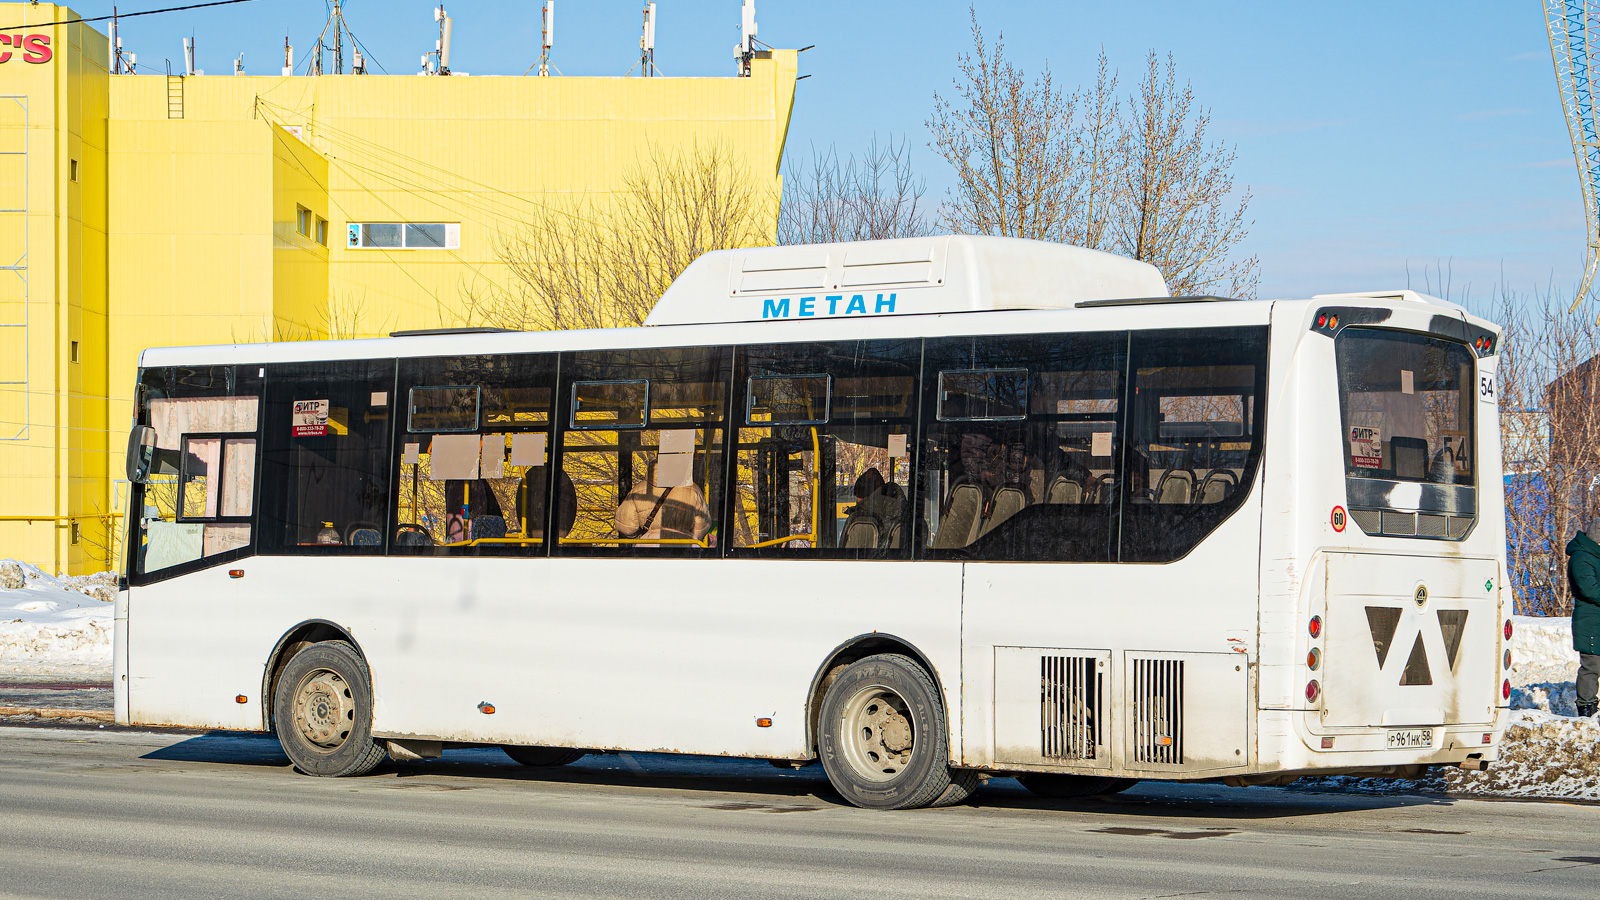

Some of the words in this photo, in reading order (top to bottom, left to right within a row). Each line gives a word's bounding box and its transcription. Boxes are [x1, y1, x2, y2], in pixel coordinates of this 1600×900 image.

[762, 293, 897, 319] МЕТАН
[1481, 377, 1493, 397] 54
[303, 401, 320, 411] ИТР
[1358, 428, 1373, 440] ИТР
[1443, 436, 1468, 470] 54
[1334, 512, 1343, 525] 60
